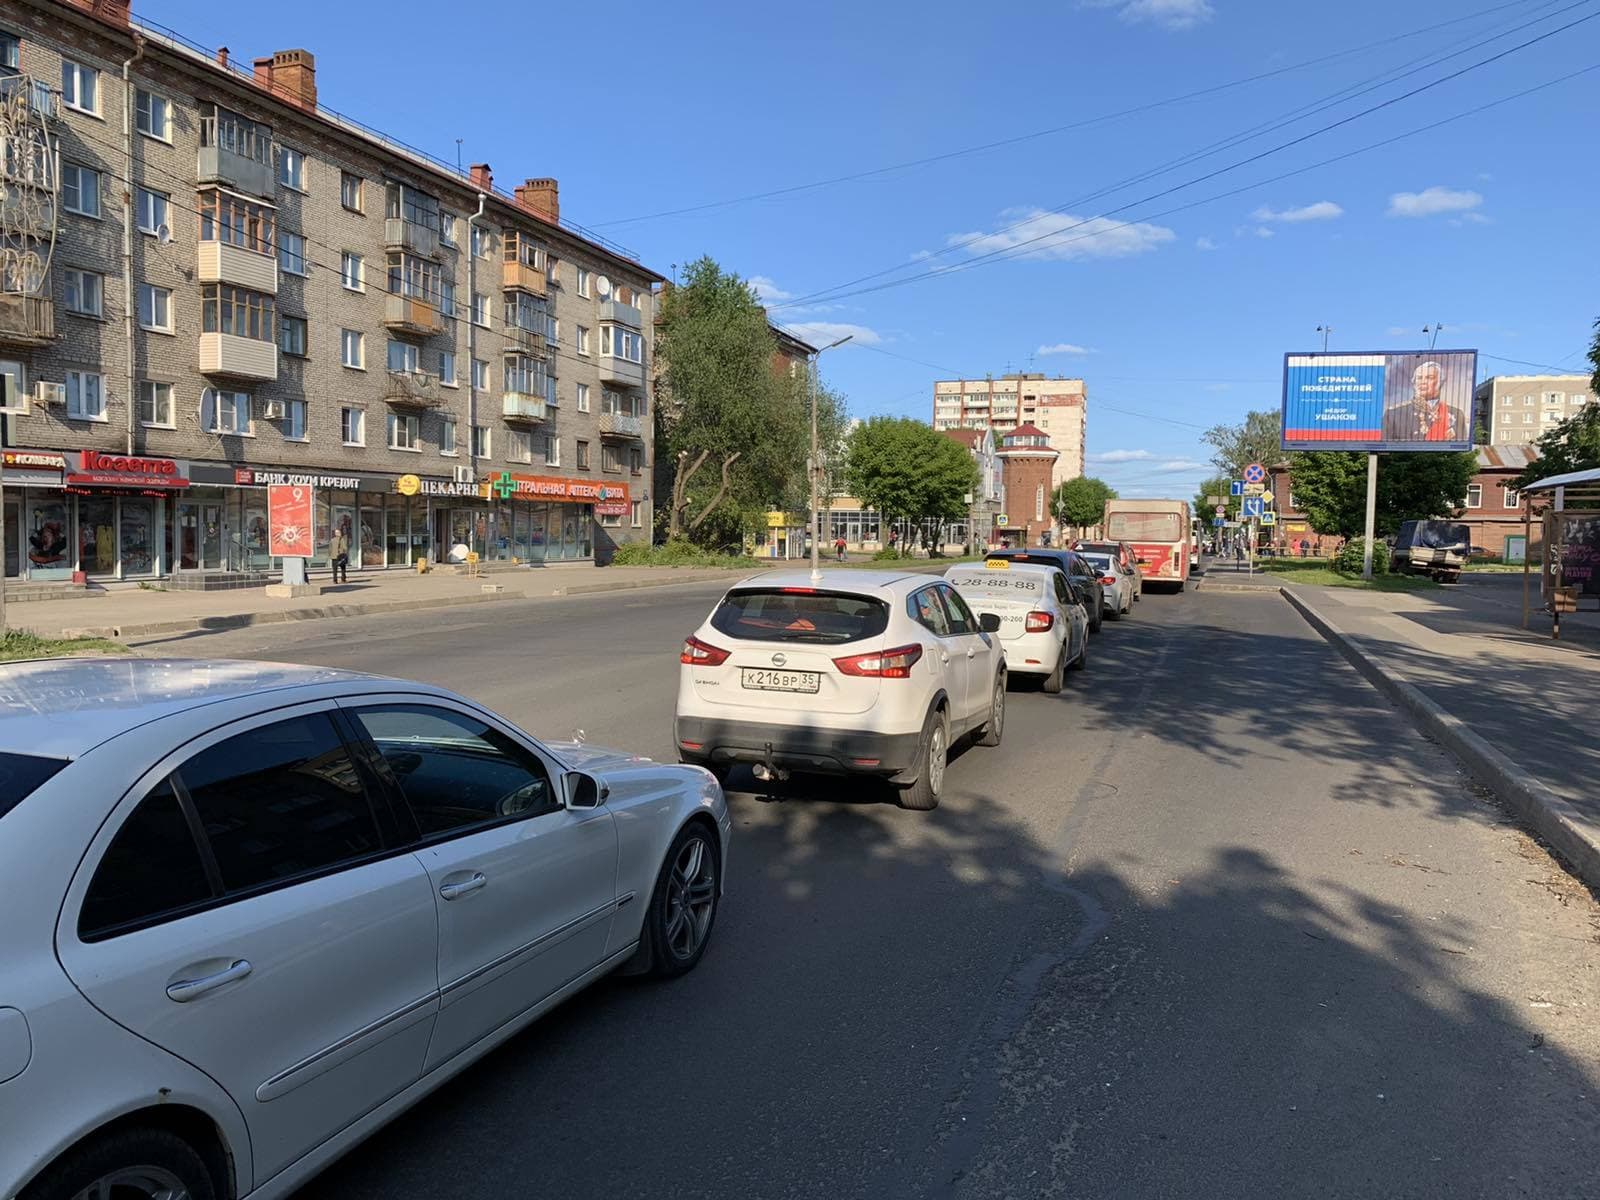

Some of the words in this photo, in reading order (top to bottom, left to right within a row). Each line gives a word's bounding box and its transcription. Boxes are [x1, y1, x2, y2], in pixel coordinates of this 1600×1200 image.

[1301, 384, 1372, 392] ПОБЕДИТЕЛЕЙ
[80, 449, 177, 475] Козетта
[255, 472, 287, 484] БАНК
[287, 474, 318, 486] ХОУМ
[320, 476, 360, 488] КРЕДИТ
[293, 487, 302, 502] 9
[420, 480, 479, 496] ПЕКАРНЯ
[568, 484, 597, 497] АПТЕКА
[961, 579, 1036, 591] 28-88-88
[802, 674, 816, 685] 35
